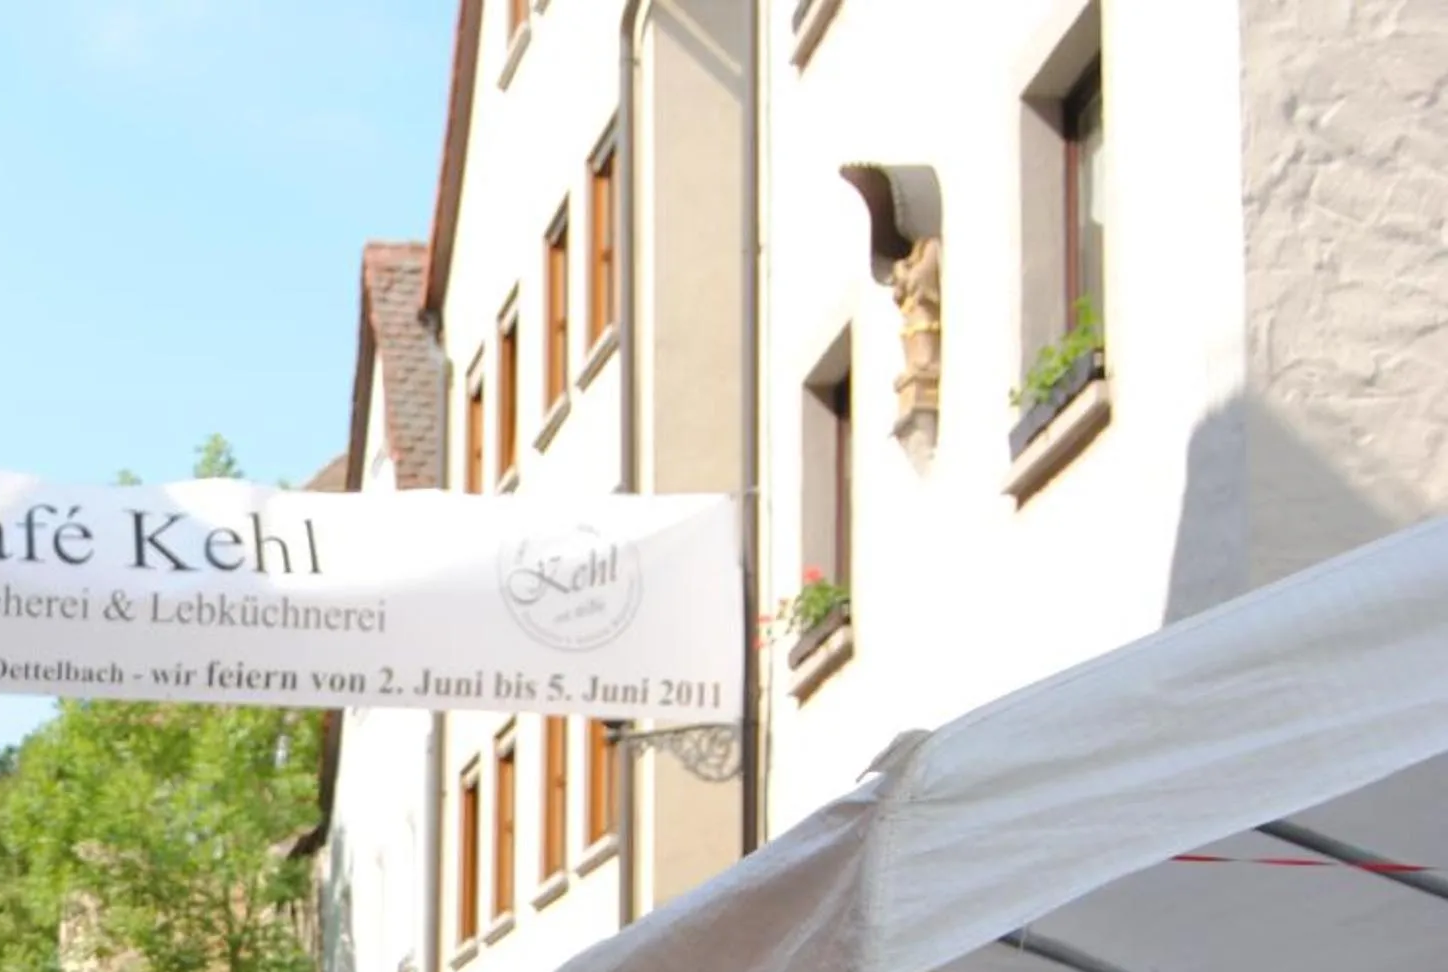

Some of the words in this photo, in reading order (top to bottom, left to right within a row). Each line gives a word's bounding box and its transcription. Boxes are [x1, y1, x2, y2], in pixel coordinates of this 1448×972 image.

[126, 508, 322, 574] Kehl
[103, 589, 136, 622] &
[150, 592, 387, 633] Lebküchnerei
[151, 661, 197, 687] wir
[206, 660, 297, 691] feiern
[311, 670, 366, 694] von
[379, 667, 403, 695] 2.
[413, 670, 483, 698] Juni
[494, 671, 537, 700] bis
[547, 673, 572, 702] 5.
[581, 676, 649, 705] Juni
[658, 679, 722, 709] 2011
